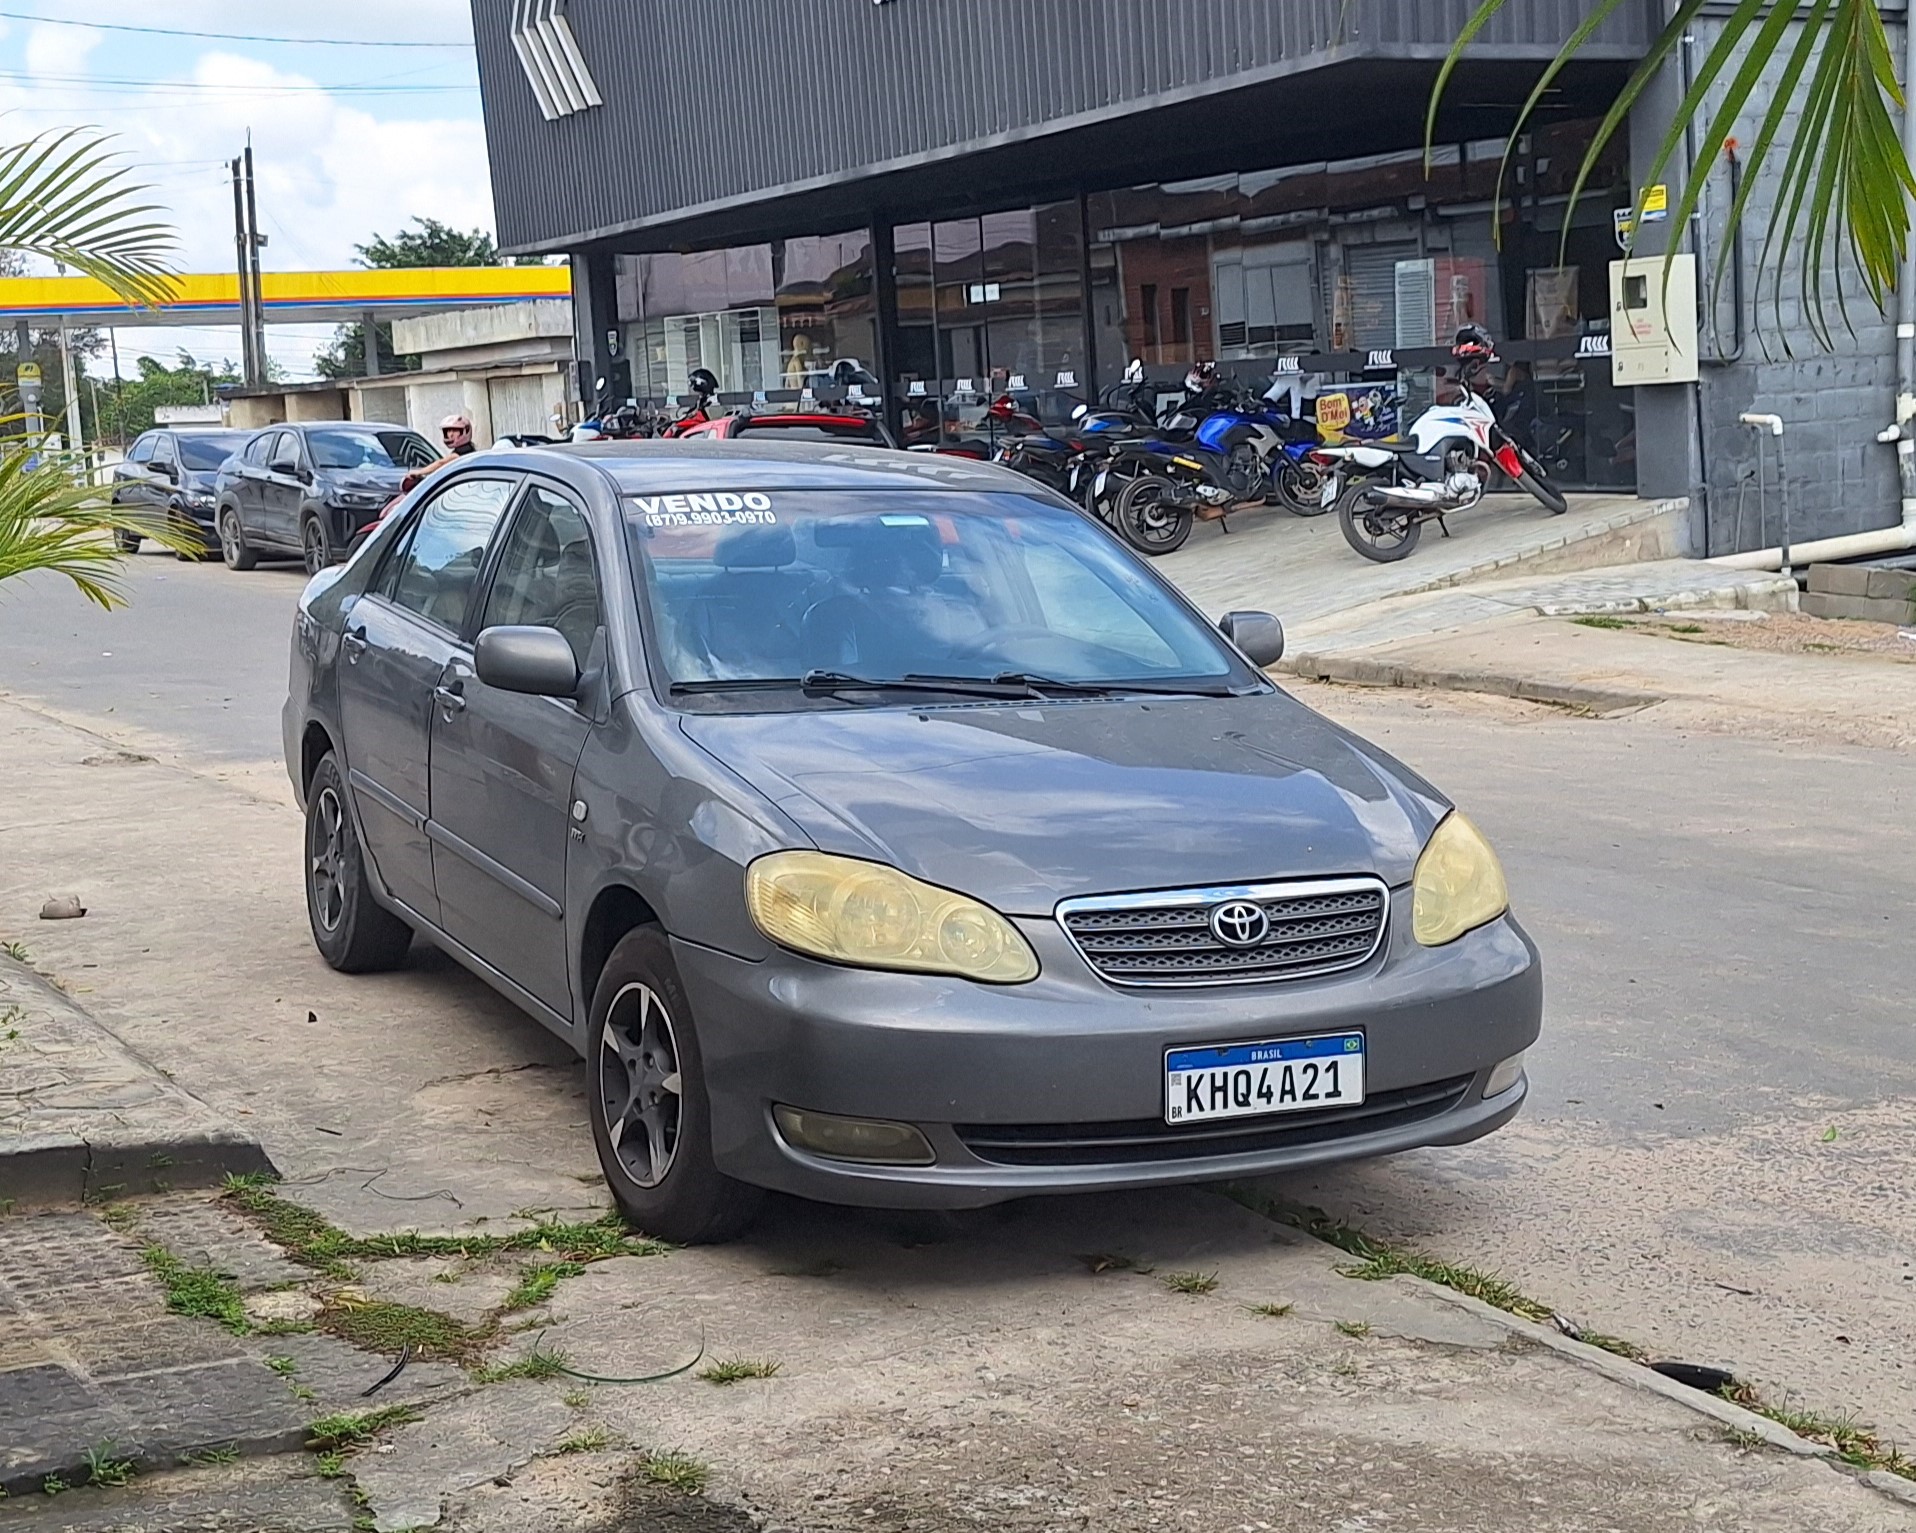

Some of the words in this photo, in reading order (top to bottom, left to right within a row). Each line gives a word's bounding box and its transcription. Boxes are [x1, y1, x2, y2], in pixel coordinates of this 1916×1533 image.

[633, 492, 772, 514] VENDO
[1251, 1049, 1282, 1061] BRASIL
[1186, 1060, 1342, 1113] KHQ4A21
[1171, 1106, 1183, 1119] BR
